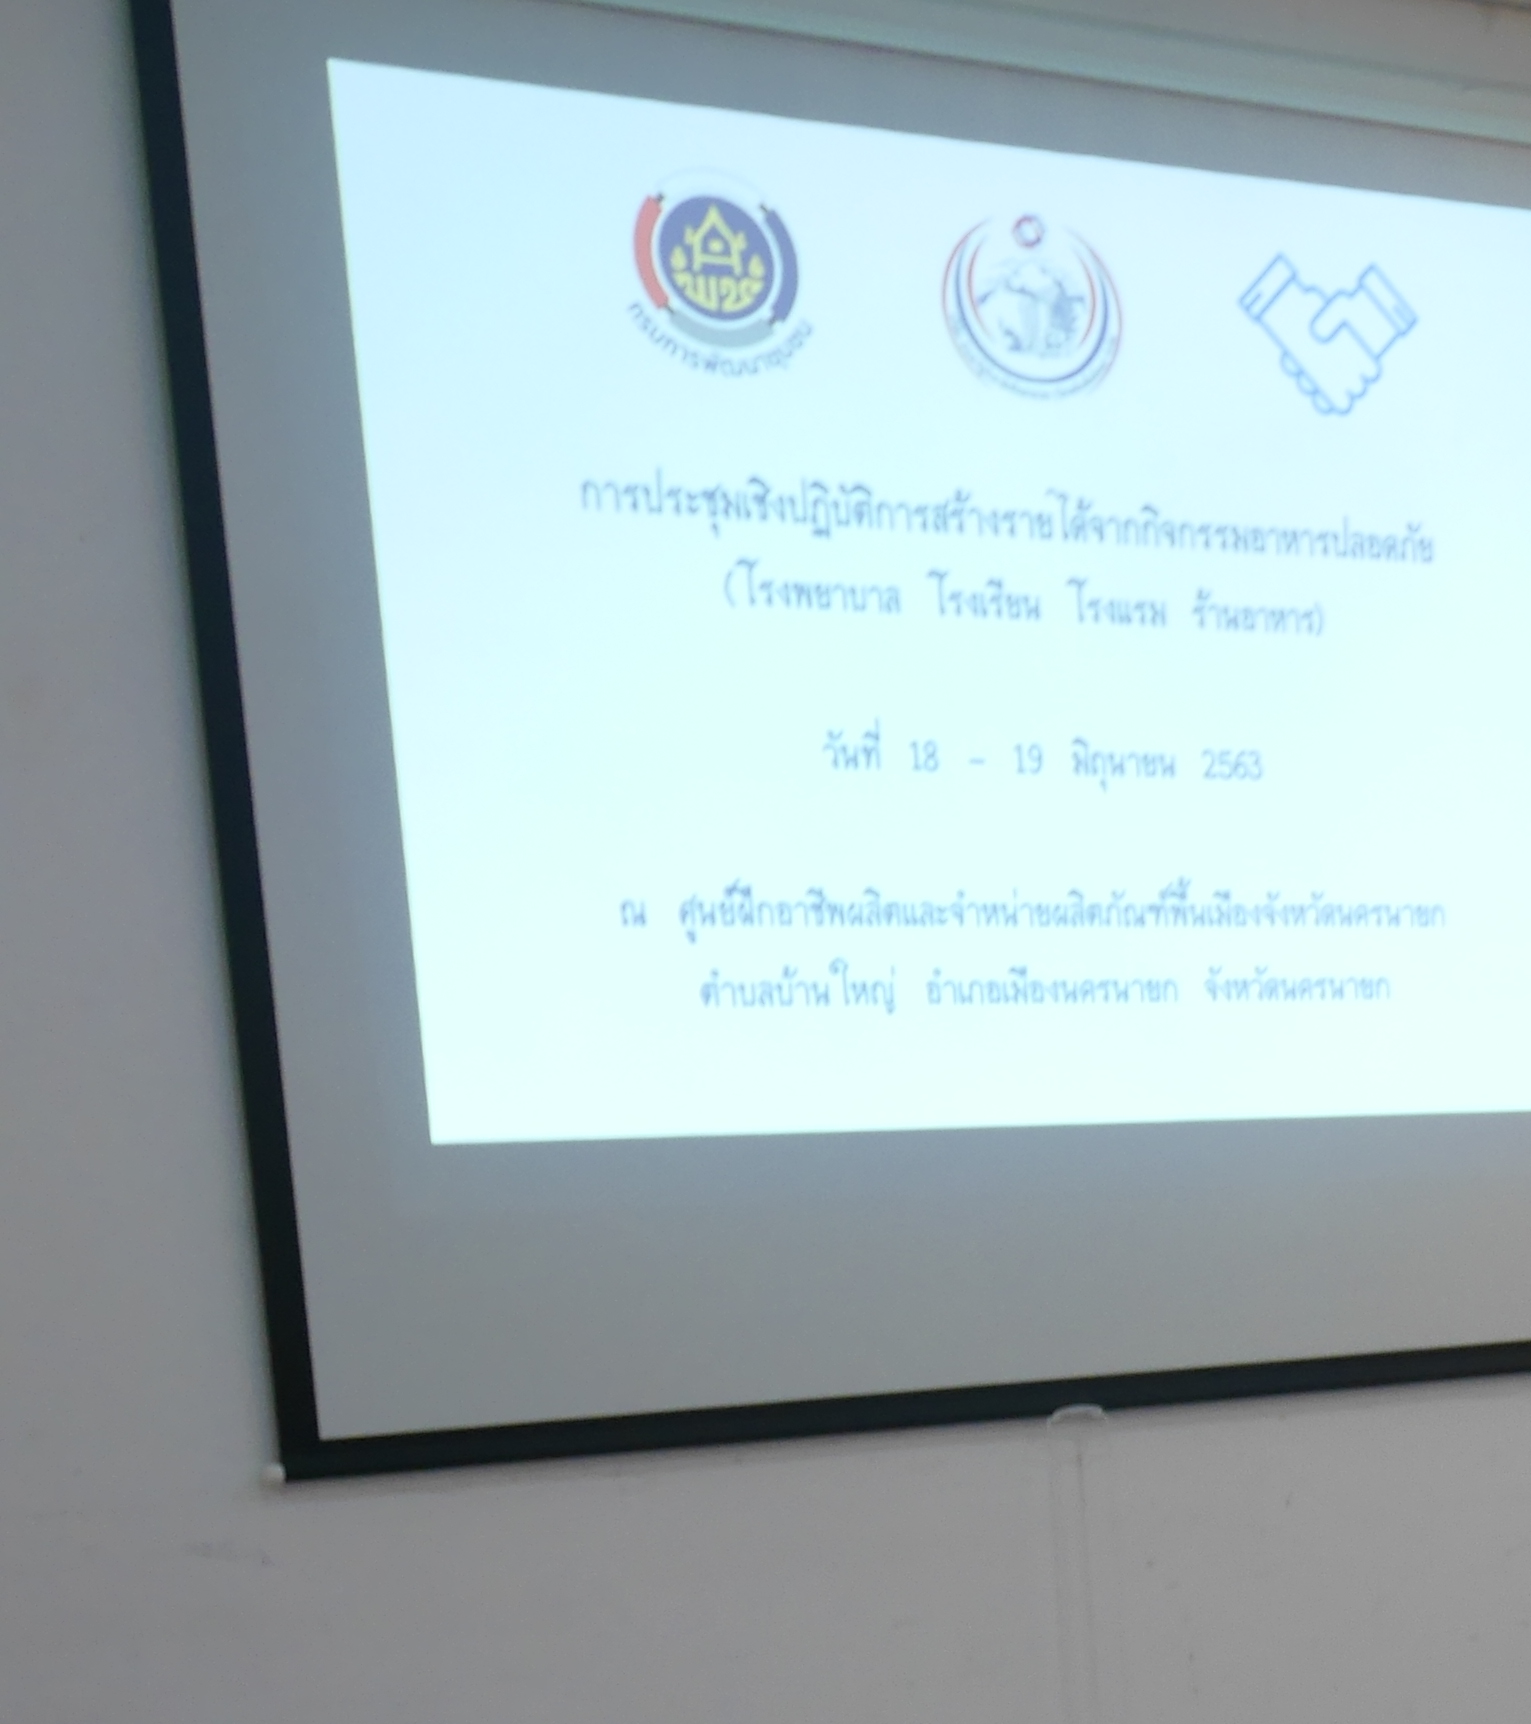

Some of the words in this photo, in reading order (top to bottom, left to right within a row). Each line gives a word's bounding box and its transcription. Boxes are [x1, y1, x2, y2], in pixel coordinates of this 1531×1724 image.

[725, 557, 902, 615] (โรงพยาบาล
[931, 568, 1043, 623] โรงเรียน
[1067, 577, 1167, 628] โรงแรม
[1191, 589, 1325, 637] ร้านอาหาร)
[822, 717, 883, 772] วันที่
[908, 740, 940, 774] 18
[1013, 743, 1044, 775] 19
[1071, 736, 1177, 792] มิถุนายน
[1201, 747, 1264, 781] 2563
[619, 901, 647, 929] ณ
[699, 958, 897, 1016] ตำบลบ้านใหญ่
[926, 965, 1180, 1007] อำเภอเมืองนครนายก
[1203, 965, 1392, 1004] จังหวัดนครนายก
